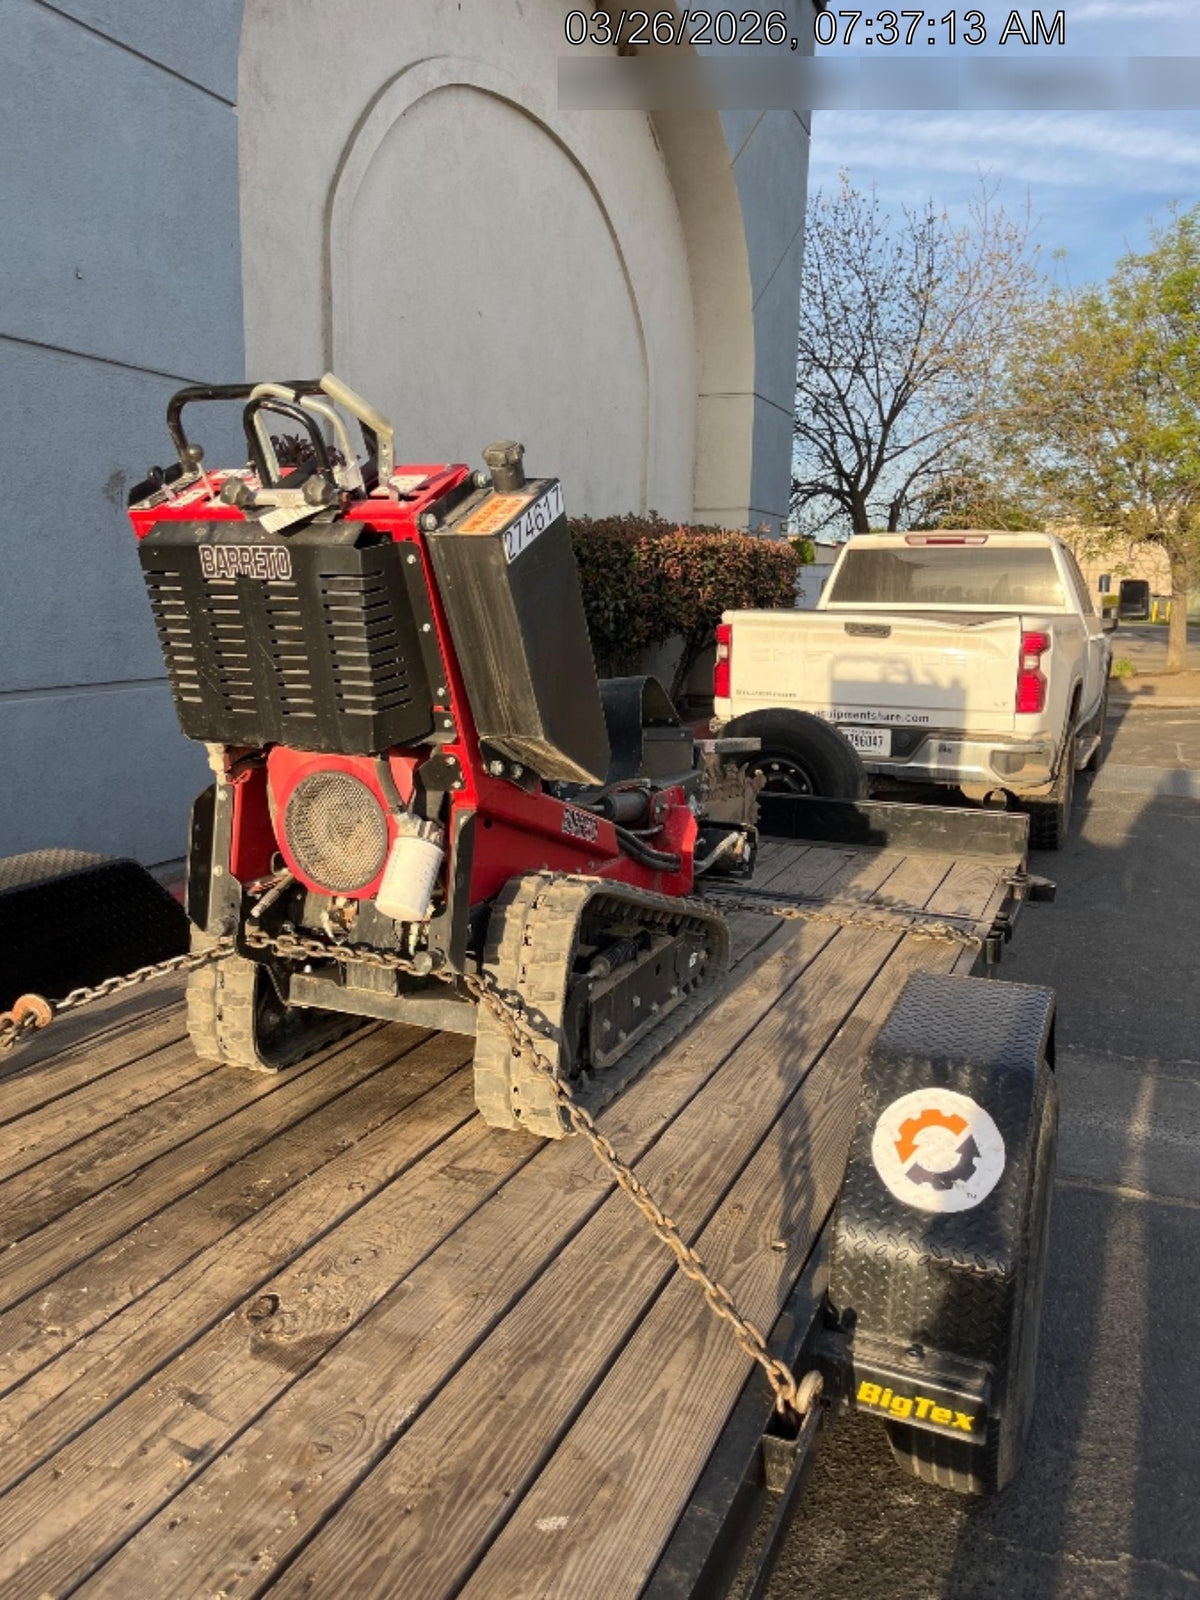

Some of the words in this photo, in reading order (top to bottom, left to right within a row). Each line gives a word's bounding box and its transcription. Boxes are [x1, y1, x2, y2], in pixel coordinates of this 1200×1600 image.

[503, 484, 561, 561] 274617
[198, 544, 293, 580] BARRETO
[856, 1380, 976, 1432] BigTex
